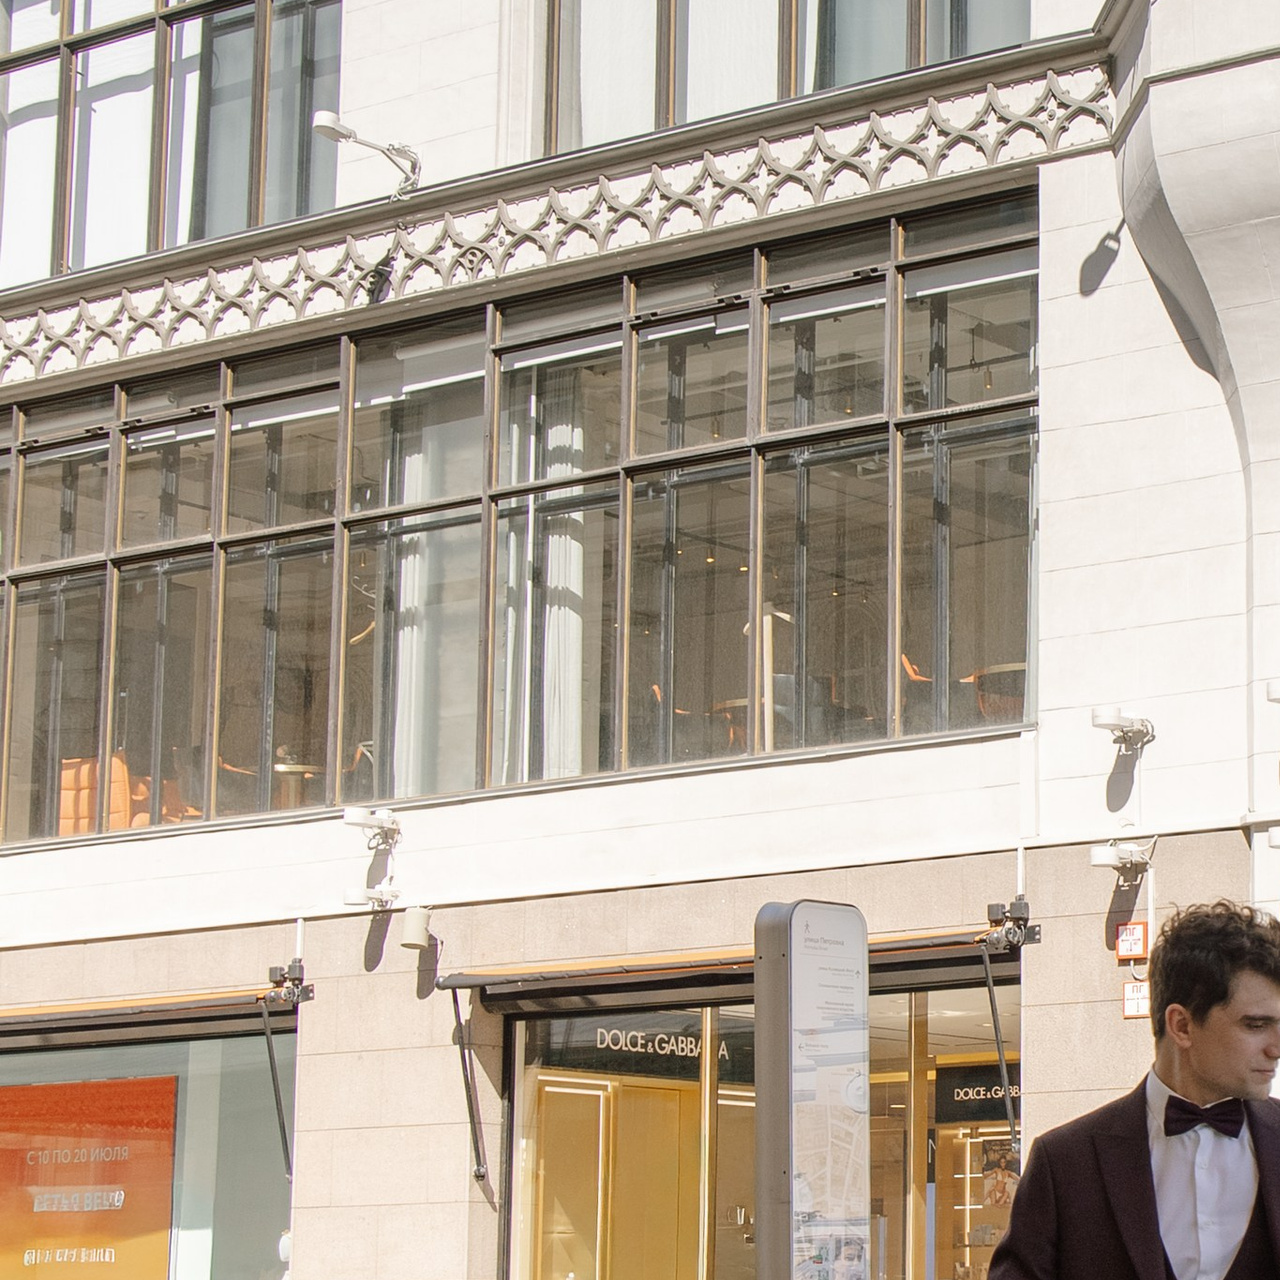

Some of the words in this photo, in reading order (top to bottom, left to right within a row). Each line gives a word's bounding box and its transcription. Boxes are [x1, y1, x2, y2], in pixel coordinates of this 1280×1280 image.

[596, 1028, 646, 1053] DOLCE
[647, 1041, 654, 1053] &
[954, 1087, 985, 1100] DOLCE
[26, 1151, 36, 1165] С
[38, 1150, 50, 1165] 10
[52, 1149, 71, 1164] ПО
[74, 1148, 87, 1163] 20
[90, 1146, 129, 1162] ИЮЛЯ
